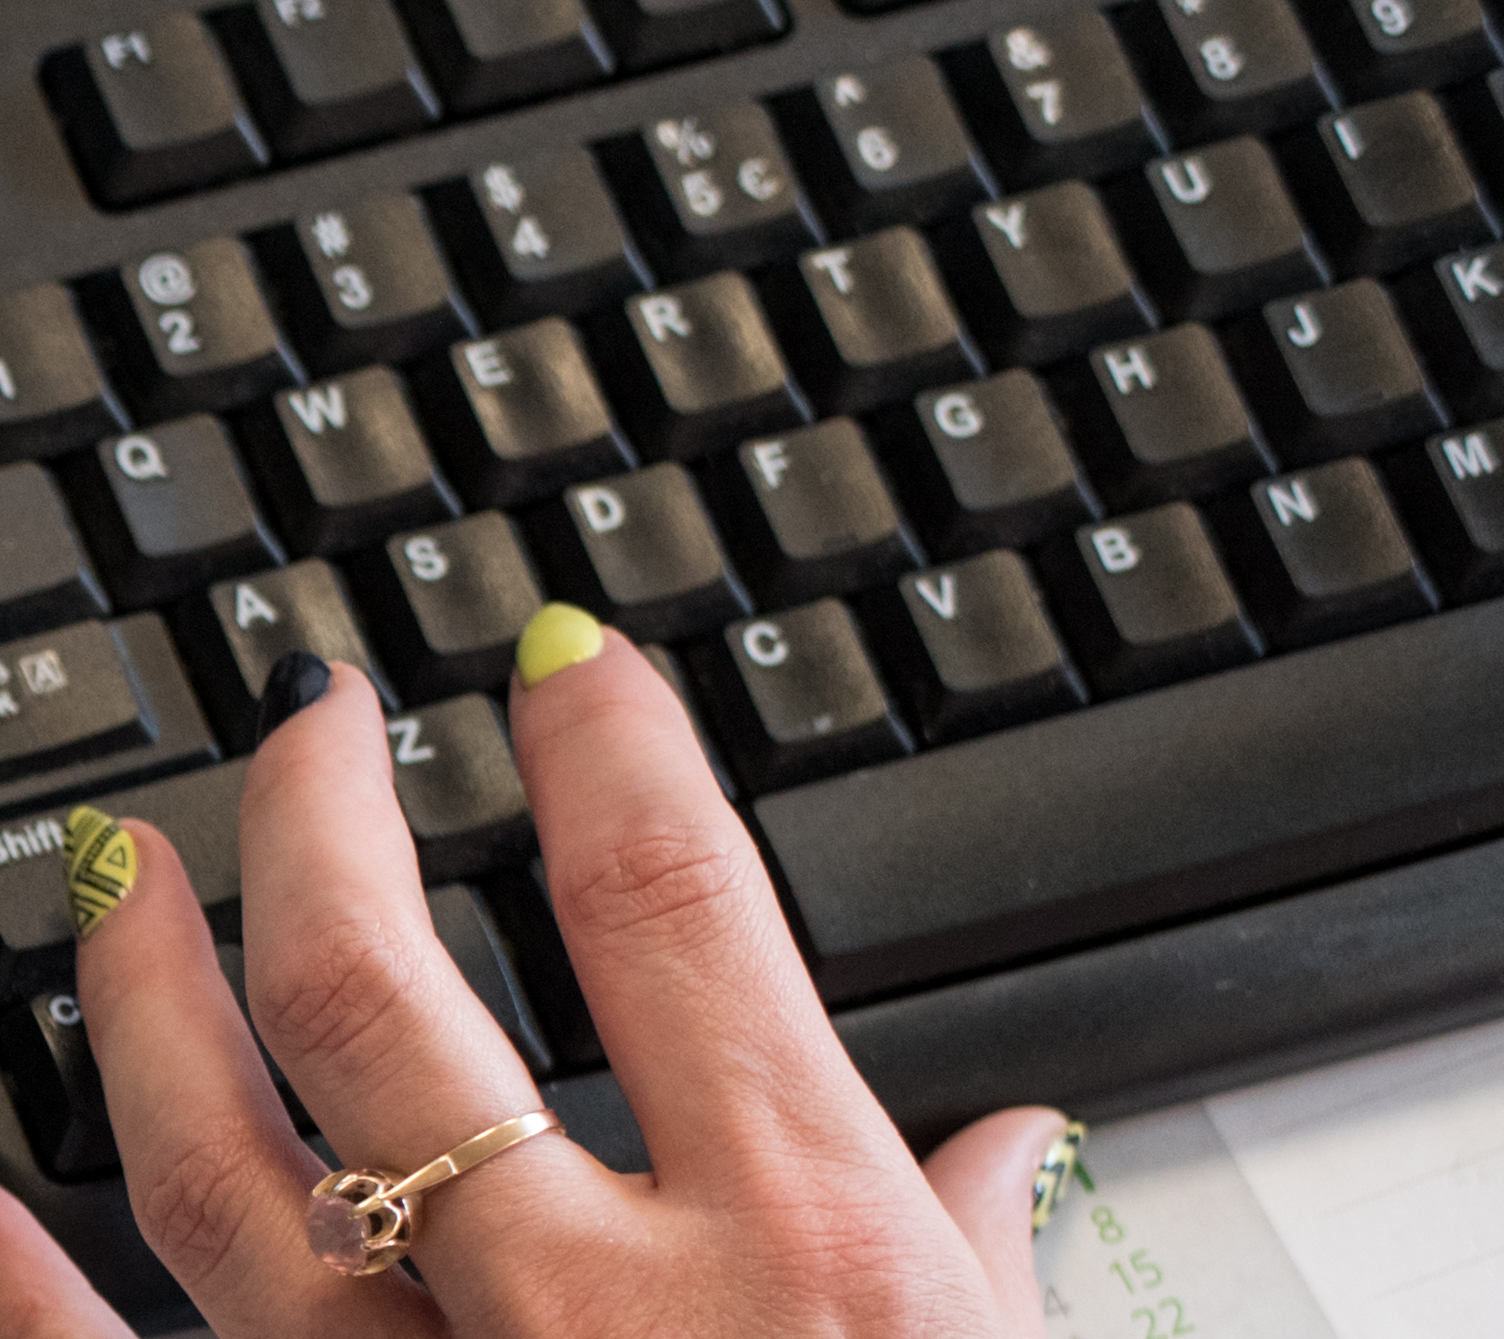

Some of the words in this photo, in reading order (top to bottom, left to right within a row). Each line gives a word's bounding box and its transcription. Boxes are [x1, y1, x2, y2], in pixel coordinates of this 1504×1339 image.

[102, 32, 152, 69] F1
[1162, 157, 1213, 203] U
[987, 201, 1027, 249] Y
[464, 341, 514, 387] E
[1104, 346, 1159, 394] H
[289, 387, 346, 435] W
[933, 394, 985, 439] G
[114, 436, 167, 480] Q
[1267, 479, 1320, 526] N
[1090, 527, 1141, 573] B
[234, 584, 278, 630] A
[1108, 1247, 1165, 1297] 15
